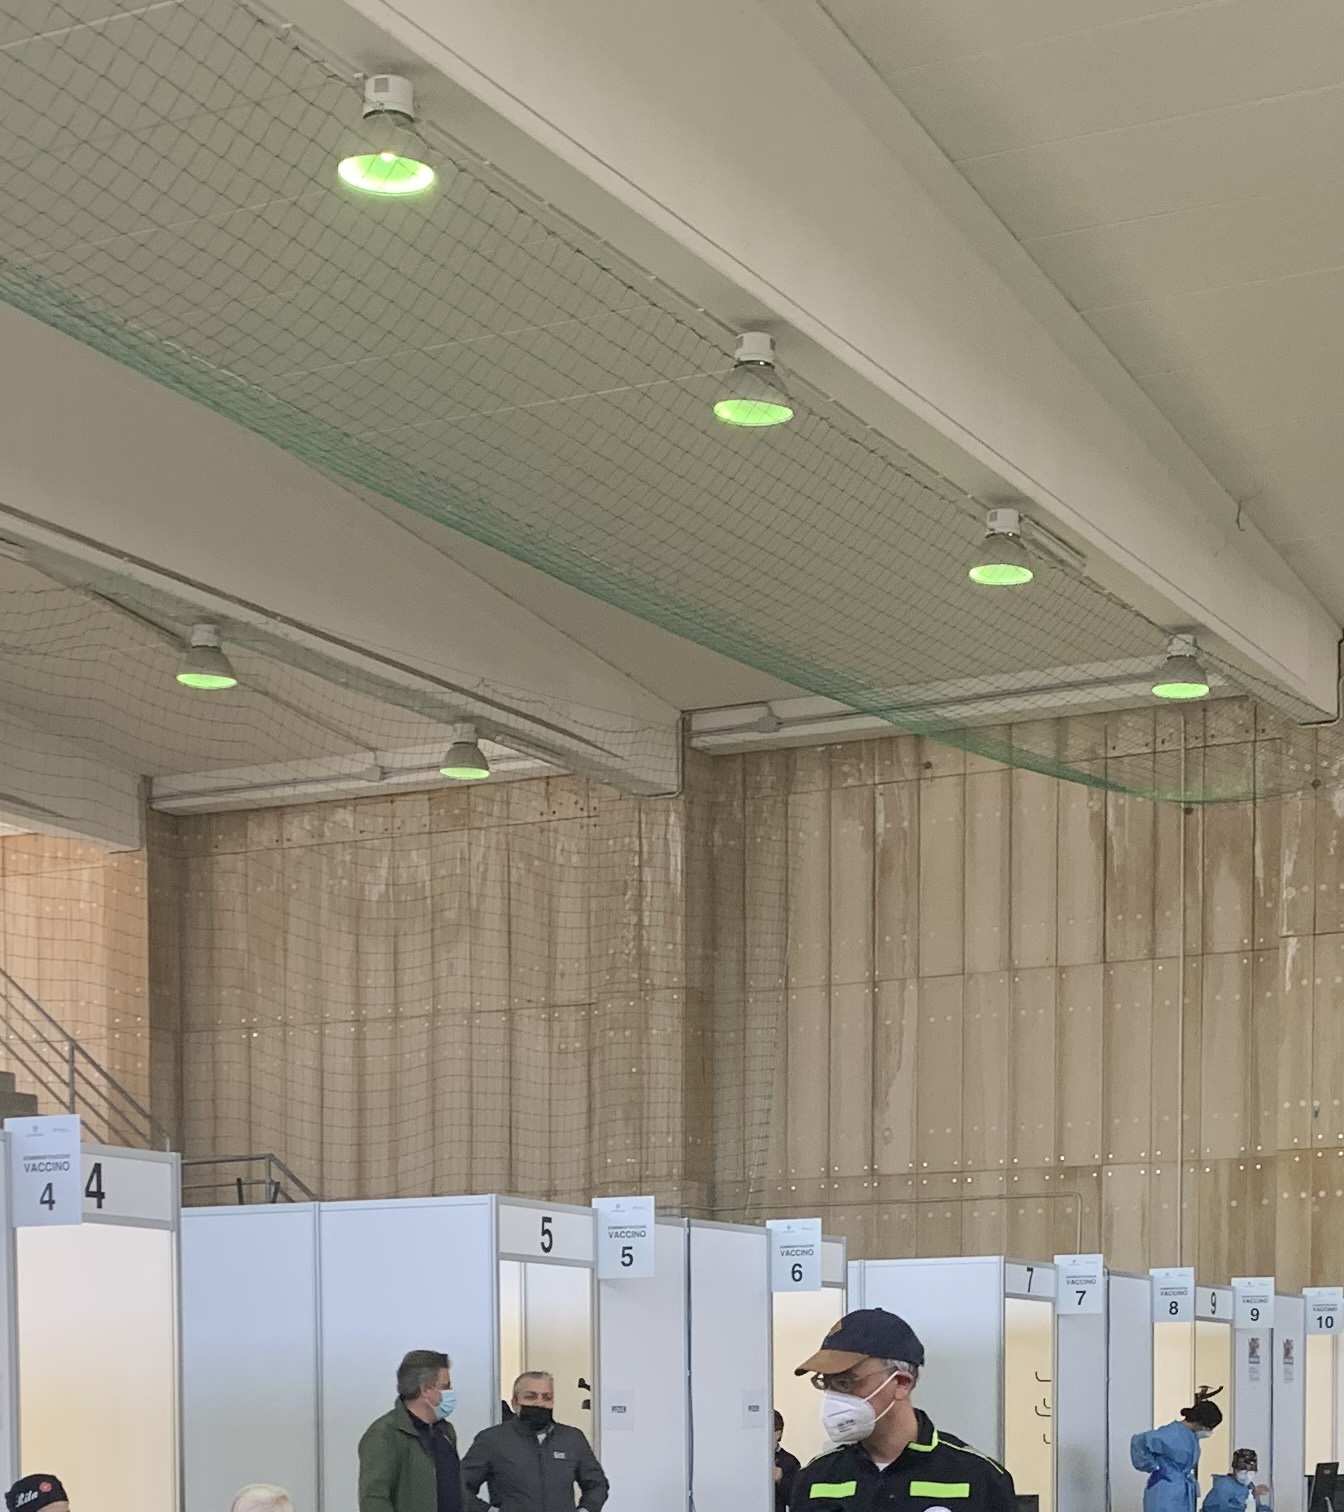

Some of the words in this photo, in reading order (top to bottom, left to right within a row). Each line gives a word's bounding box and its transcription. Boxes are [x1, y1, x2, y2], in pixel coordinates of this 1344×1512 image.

[23, 1161, 71, 1173] VACCINO
[84, 1162, 106, 1209] 4
[39, 1182, 56, 1211] 4
[540, 1216, 553, 1254] 5
[608, 1230, 647, 1239] VACCINO
[620, 1246, 634, 1267] 5
[780, 1248, 814, 1257] VACCINO
[791, 1263, 803, 1283] 6
[1026, 1266, 1034, 1293] 7
[1075, 1290, 1087, 1306] 7
[1210, 1291, 1217, 1315] 9
[1168, 1301, 1179, 1316] 8
[1249, 1308, 1260, 1322] 9
[1316, 1316, 1334, 1329] 10
